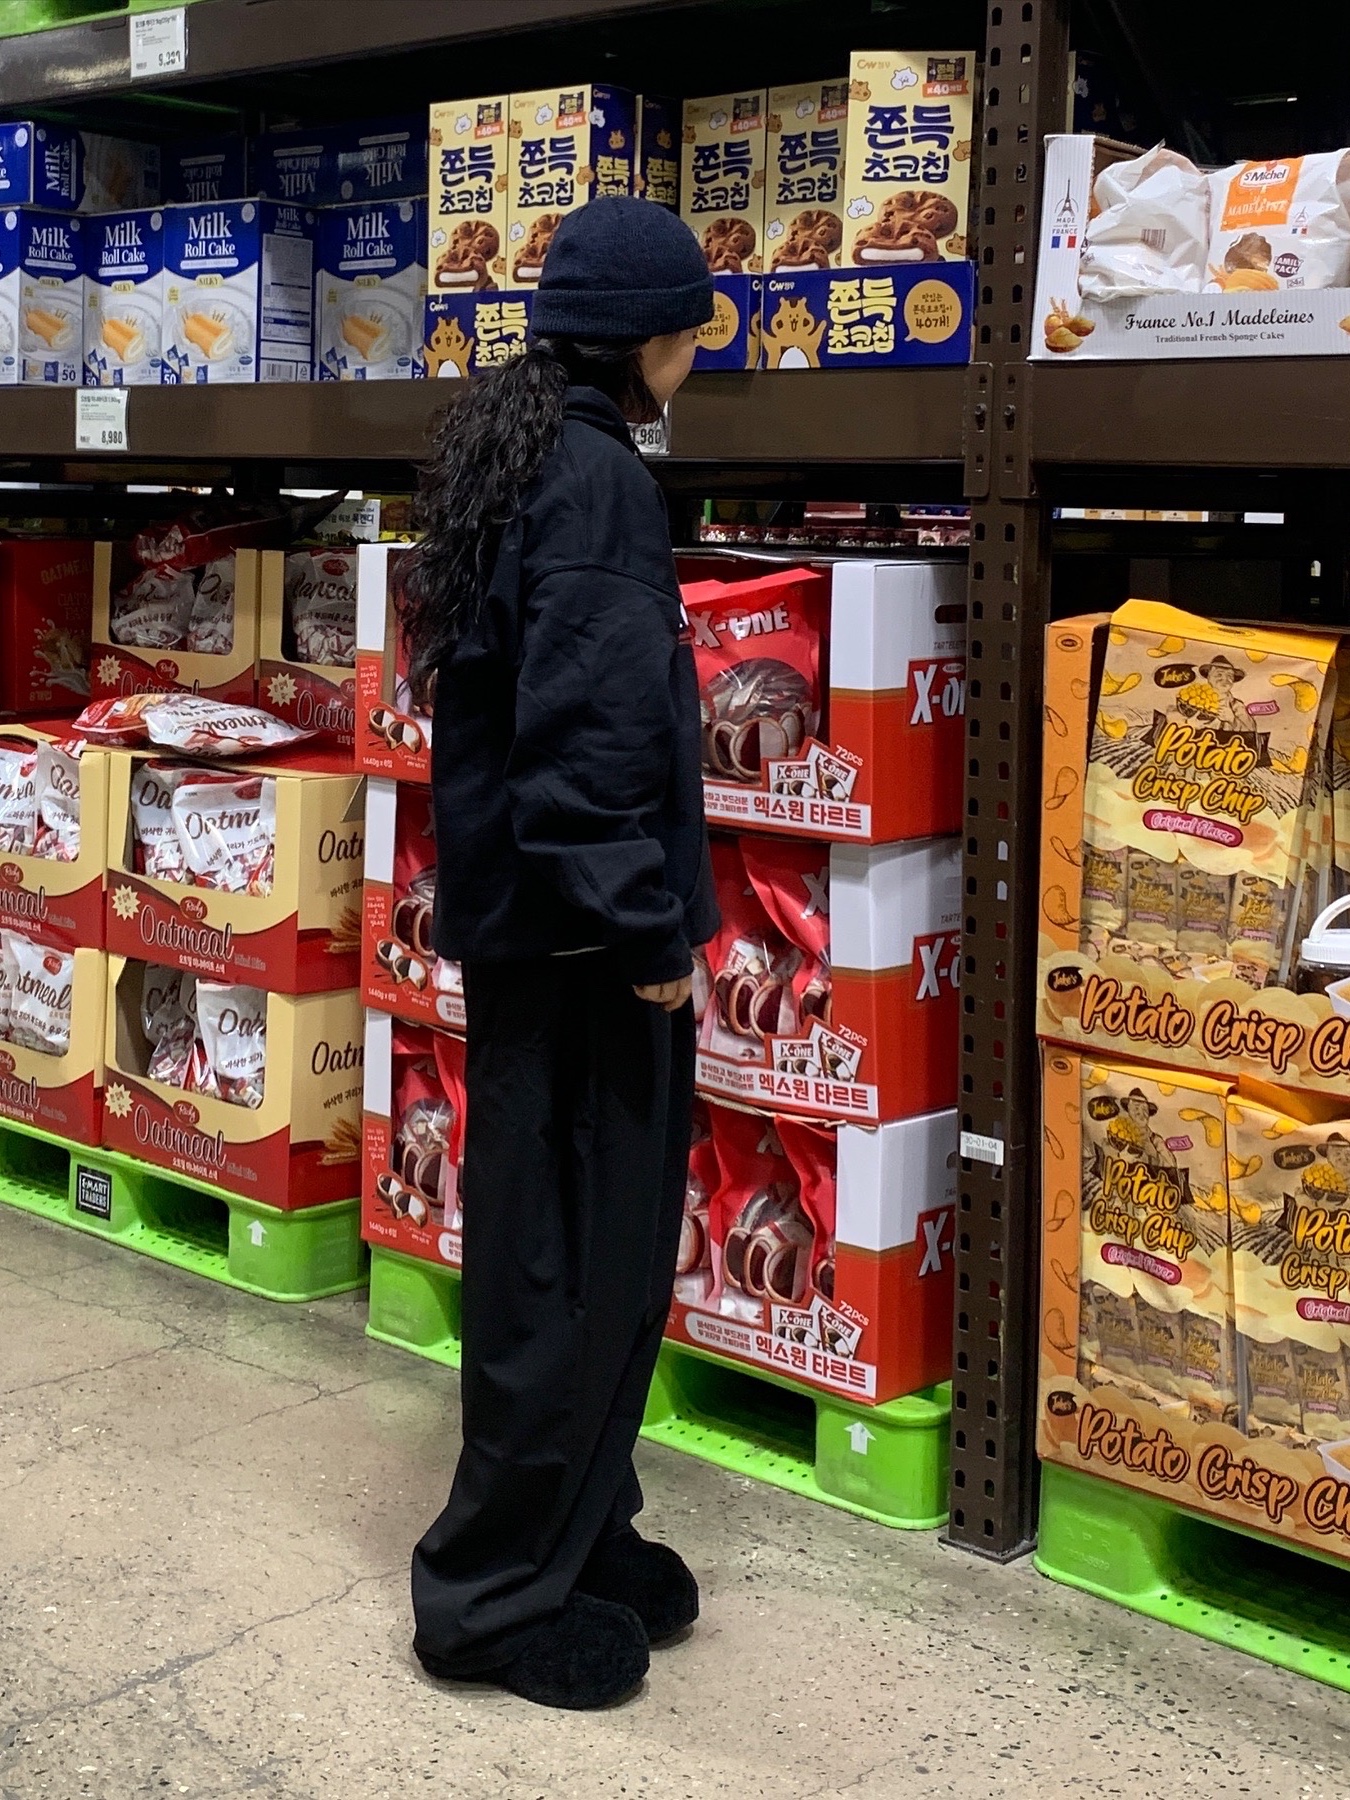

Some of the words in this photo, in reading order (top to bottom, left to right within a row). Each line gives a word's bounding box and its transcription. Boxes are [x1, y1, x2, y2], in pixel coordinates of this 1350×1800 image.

[864, 104, 954, 150] 쫀득
[439, 144, 495, 188] 쫀득
[518, 135, 577, 180] 쫀득
[691, 138, 753, 184] 쫀득
[777, 128, 841, 175] 쫀득
[46, 143, 60, 191] Milk
[367, 160, 403, 188] Milk
[862, 152, 950, 184] 초코칩
[281, 172, 316, 197] Milk
[517, 178, 574, 208] 초코칩
[690, 182, 750, 214] 초코칩
[776, 172, 838, 205] 초코칩
[439, 185, 493, 215] 초코칩
[32, 227, 70, 248] Milk
[104, 220, 142, 249] Milk
[188, 212, 232, 240] Milk
[347, 212, 390, 241] Milk
[28, 245, 48, 260] Roll
[50, 247, 73, 262] Cake
[102, 249, 119, 265] Roll
[121, 248, 146, 263] Cake
[184, 241, 206, 258] Roll
[208, 240, 236, 256] Cake
[343, 243, 363, 259] Roll
[365, 241, 394, 257] Cake
[1275, 265, 1299, 273] PACK
[827, 277, 897, 324] 쫀득
[474, 301, 528, 342] 쫀득
[915, 316, 950, 329] 40개!
[1125, 314, 1176, 331] France
[1181, 310, 1215, 328] No.1
[1221, 308, 1314, 326] Madeleines
[827, 320, 895, 354] 초코칩
[1155, 333, 1198, 343] Traditional
[1200, 332, 1227, 341] French
[1229, 332, 1258, 344] Sponge
[1260, 331, 1285, 340] Cakes
[62, 368, 76, 382] 50
[86, 372, 97, 385] 50
[164, 373, 176, 385] 50
[102, 430, 123, 445] 8,980
[688, 602, 791, 649] X-ONE
[835, 745, 864, 767] 72pcs
[1154, 722, 1258, 778] Potato
[778, 766, 810, 779] X-ONE
[818, 753, 850, 780] X-ONE
[1132, 767, 1201, 812] Crisp
[1200, 778, 1267, 826] Chip
[754, 795, 804, 823] 엑스원
[810, 803, 862, 830] 타르트
[1150, 811, 1197, 832] Original
[1197, 819, 1236, 843] Flavor
[140, 904, 235, 962] Oatmeal
[838, 1024, 868, 1047] 72pcs
[1081, 974, 1196, 1049] Potato
[1201, 1000, 1305, 1075] Crisp
[781, 1043, 814, 1057] X-ONE
[820, 1032, 854, 1061] X-ONE
[758, 1073, 809, 1102] 엑스원
[814, 1081, 869, 1110] 타르트
[134, 1104, 227, 1170] Oatmeal
[81, 1188, 107, 1208] TRADERS
[1101, 1155, 1182, 1214] Potato
[1090, 1198, 1141, 1247] Crisp
[1141, 1211, 1198, 1262] Chip
[1280, 1251, 1348, 1300] Crisp
[780, 1310, 814, 1328] X-ONE
[820, 1305, 855, 1338] X-ONE
[839, 1300, 870, 1327] 72pcs
[1304, 1302, 1349, 1321] Original
[755, 1334, 807, 1371] 엑스원
[811, 1353, 867, 1390] 타르트
[1077, 1403, 1191, 1483] Potato
[1197, 1444, 1299, 1523] Crisp
